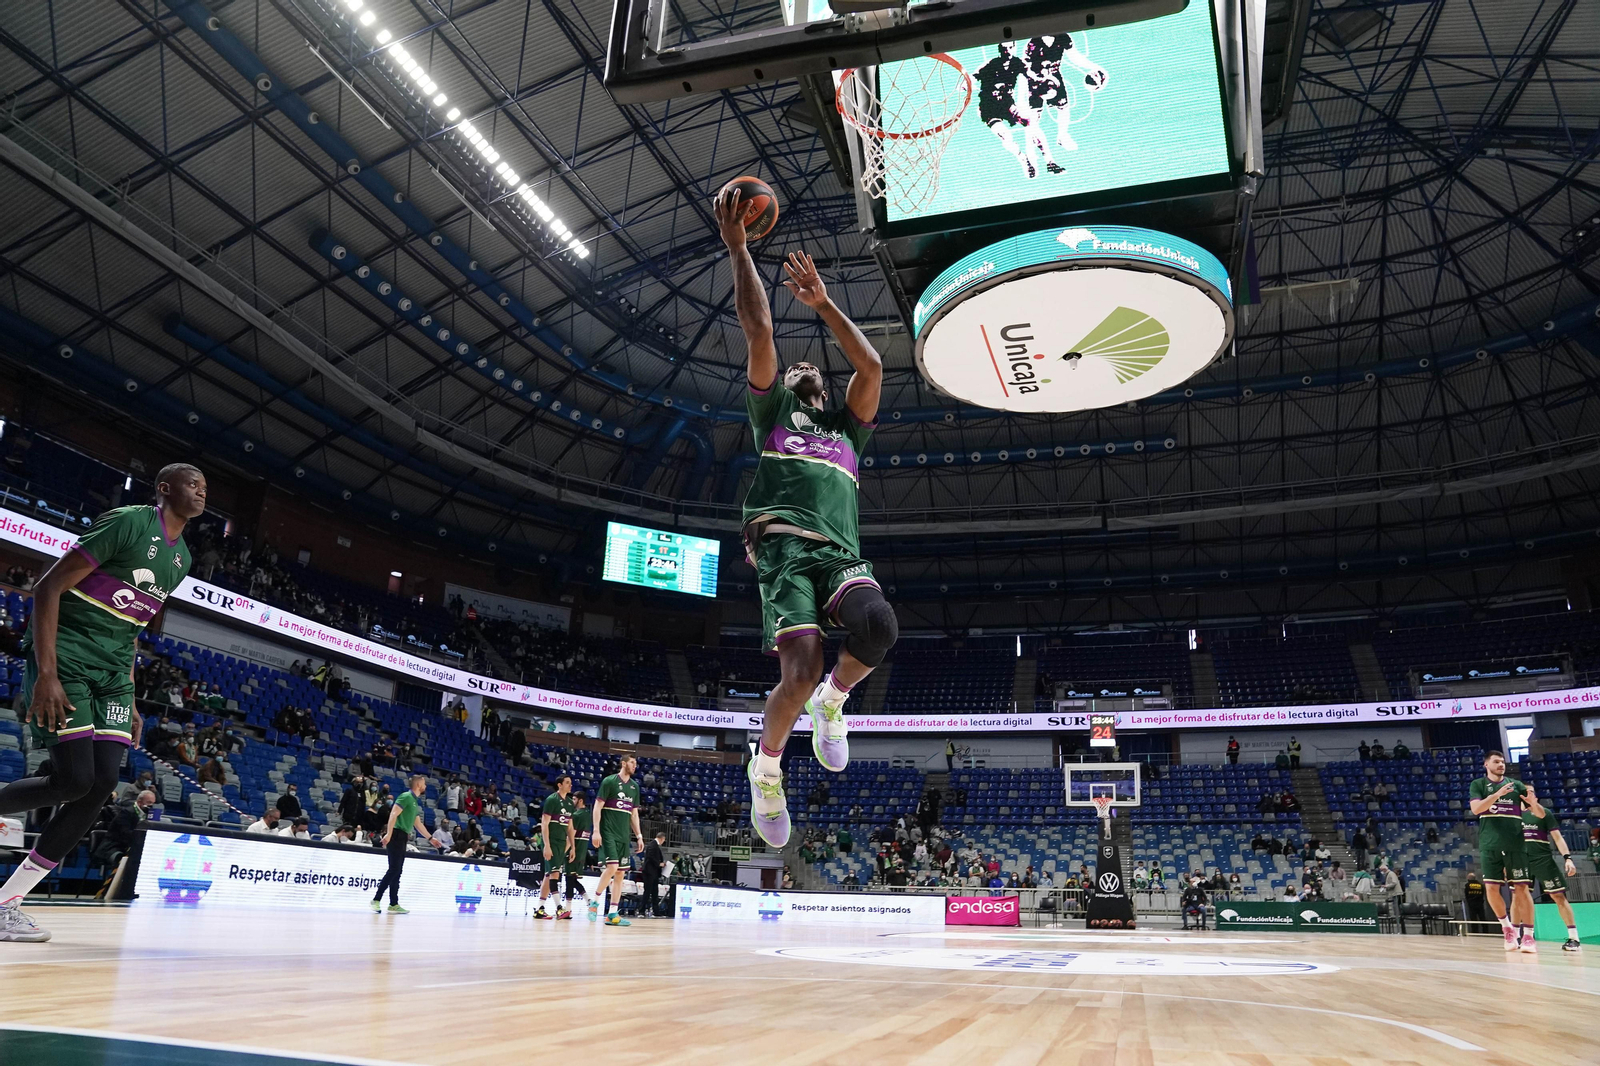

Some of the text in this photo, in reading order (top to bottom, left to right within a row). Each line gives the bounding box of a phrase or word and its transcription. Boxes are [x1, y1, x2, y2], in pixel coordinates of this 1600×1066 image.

[1093, 239, 1200, 270] FundaciónUnicaja
[999, 323, 1052, 394] Unicaja
[0, 517, 70, 551] disfrutar d
[148, 584, 169, 600] Unicaj
[191, 585, 235, 611] SUR
[279, 617, 456, 682] La mejor forma de disfrutar de la lectura digital
[467, 677, 501, 694] SUR
[538, 693, 734, 725] La mejor forma de disfrutar de la lectura digital
[1474, 692, 1600, 711] La mejor forma de dis
[1131, 708, 1359, 725] La mejor forma de disfrutar de la lectura digital
[1376, 705, 1422, 716] SUR
[847, 717, 1032, 728] ejor forma de disfrutar de la lectura digital
[1047, 716, 1088, 726] SUR
[1092, 726, 1112, 739] 24
[512, 862, 541, 871] SPALDING
[229, 864, 383, 891] Respetar asientos asigna
[791, 903, 911, 915] Respetar asientos asignados
[949, 899, 1015, 914] endesa
[1236, 915, 1293, 924] FundaciónUnicaja
[1317, 916, 1376, 925] FundaciónUnicaja
